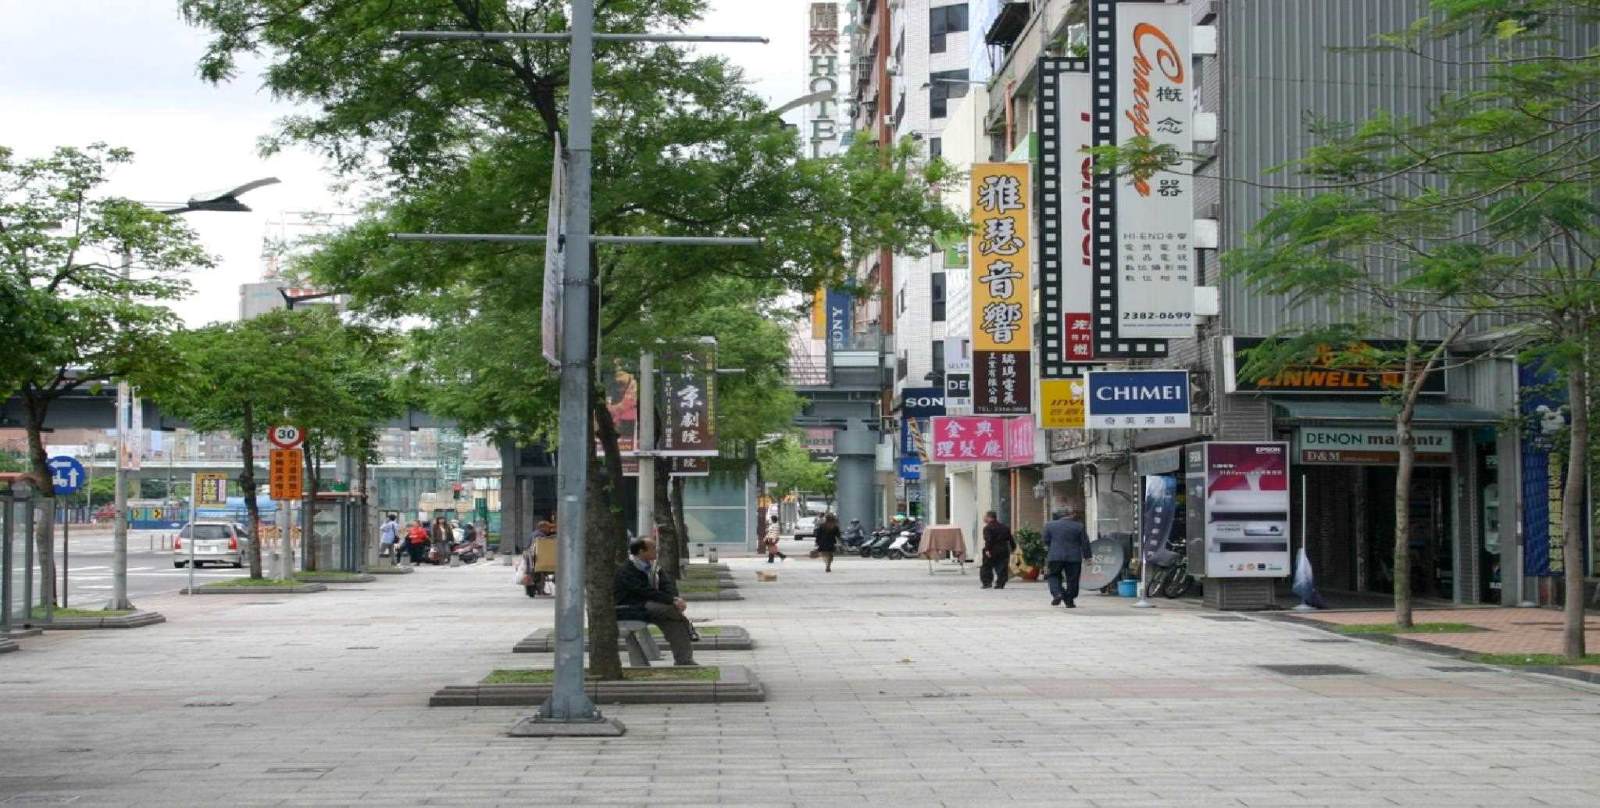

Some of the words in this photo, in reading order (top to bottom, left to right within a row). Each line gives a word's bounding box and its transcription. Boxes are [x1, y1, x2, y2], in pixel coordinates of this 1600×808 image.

[976, 174, 1026, 345] 雅瑟音響
[1122, 311, 1192, 320] 2382-0699
[948, 380, 971, 390] DE
[1096, 385, 1182, 401] CHIMEI
[278, 429, 295, 439] 30
[944, 419, 994, 438] 金典
[1305, 432, 1363, 445] DENON
[1367, 433, 1443, 446] mantz
[1255, 446, 1281, 454] EPSON
